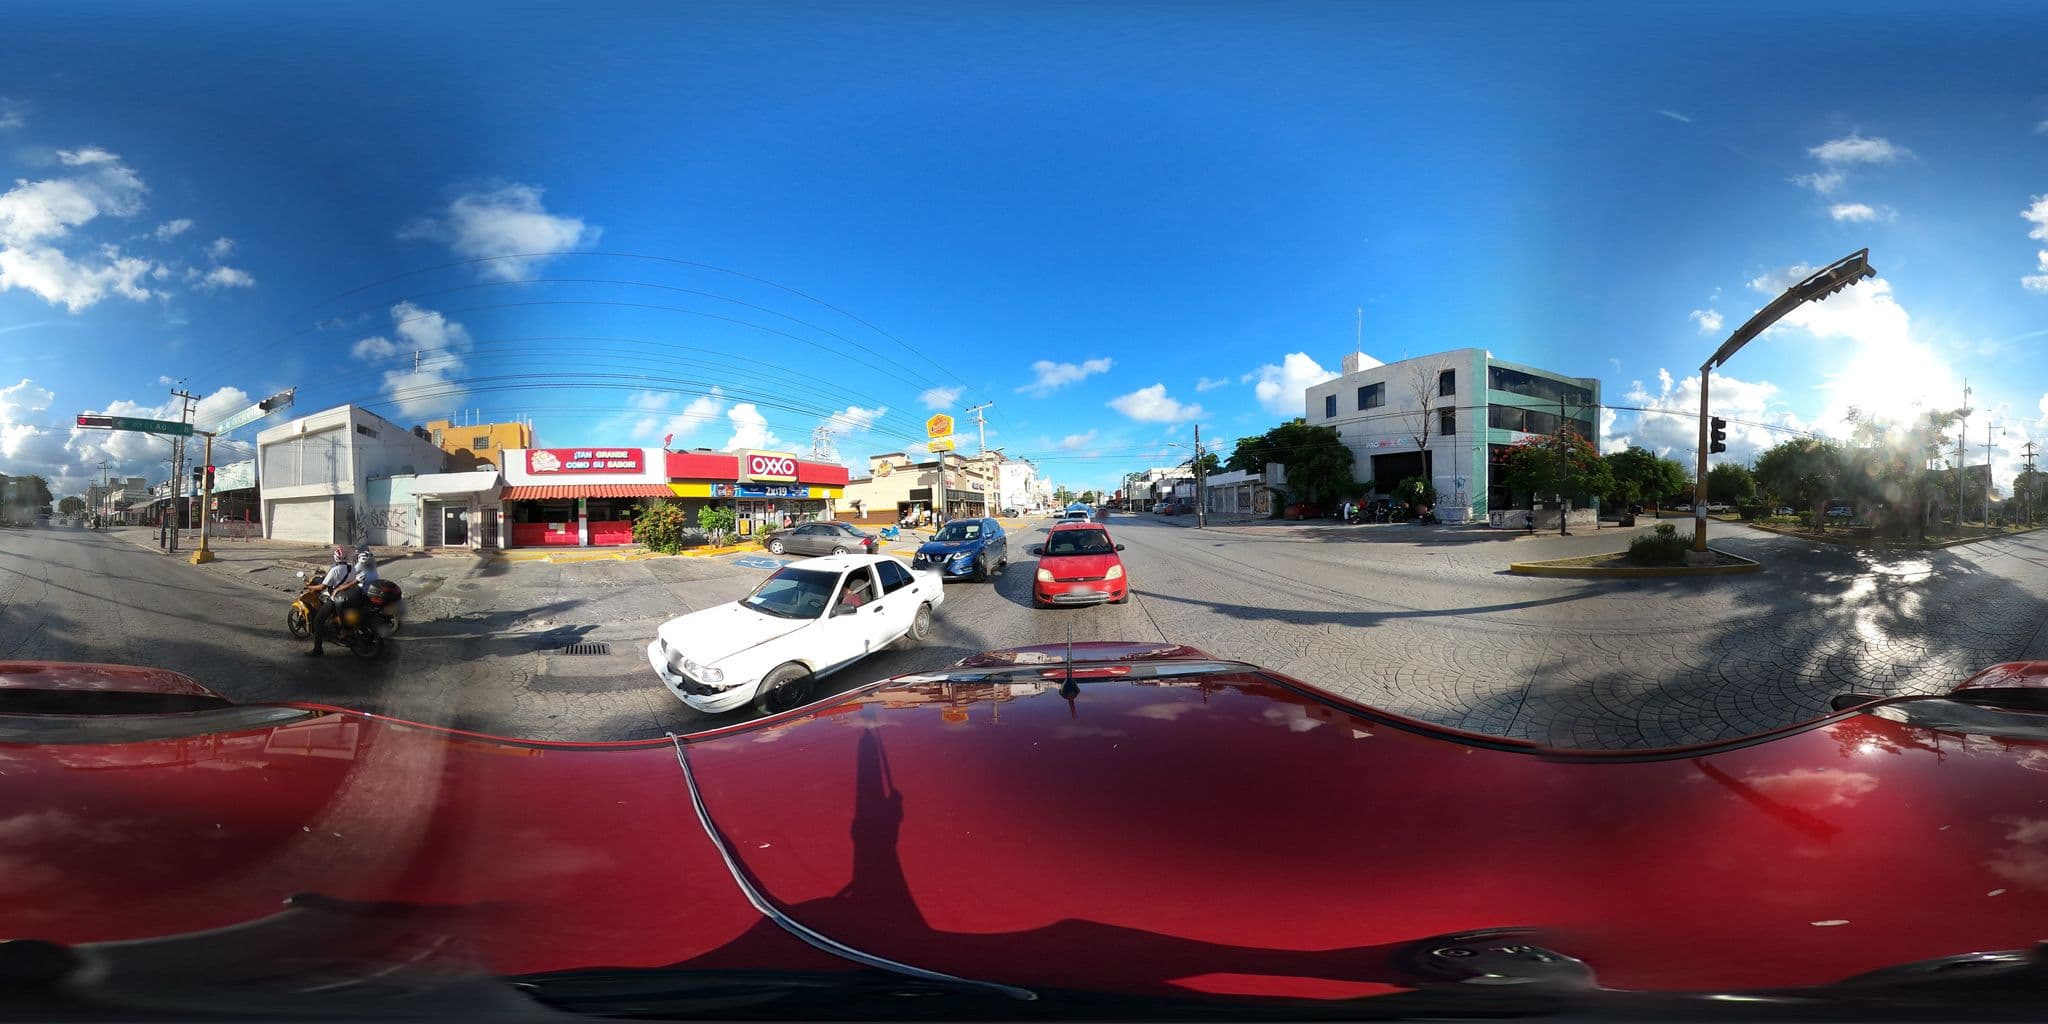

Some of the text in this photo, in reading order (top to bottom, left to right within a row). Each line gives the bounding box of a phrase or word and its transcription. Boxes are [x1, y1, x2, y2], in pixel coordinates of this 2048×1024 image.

[595, 451, 629, 459] GRANDE
[566, 461, 590, 469] COMO
[752, 457, 795, 475] OXXO
